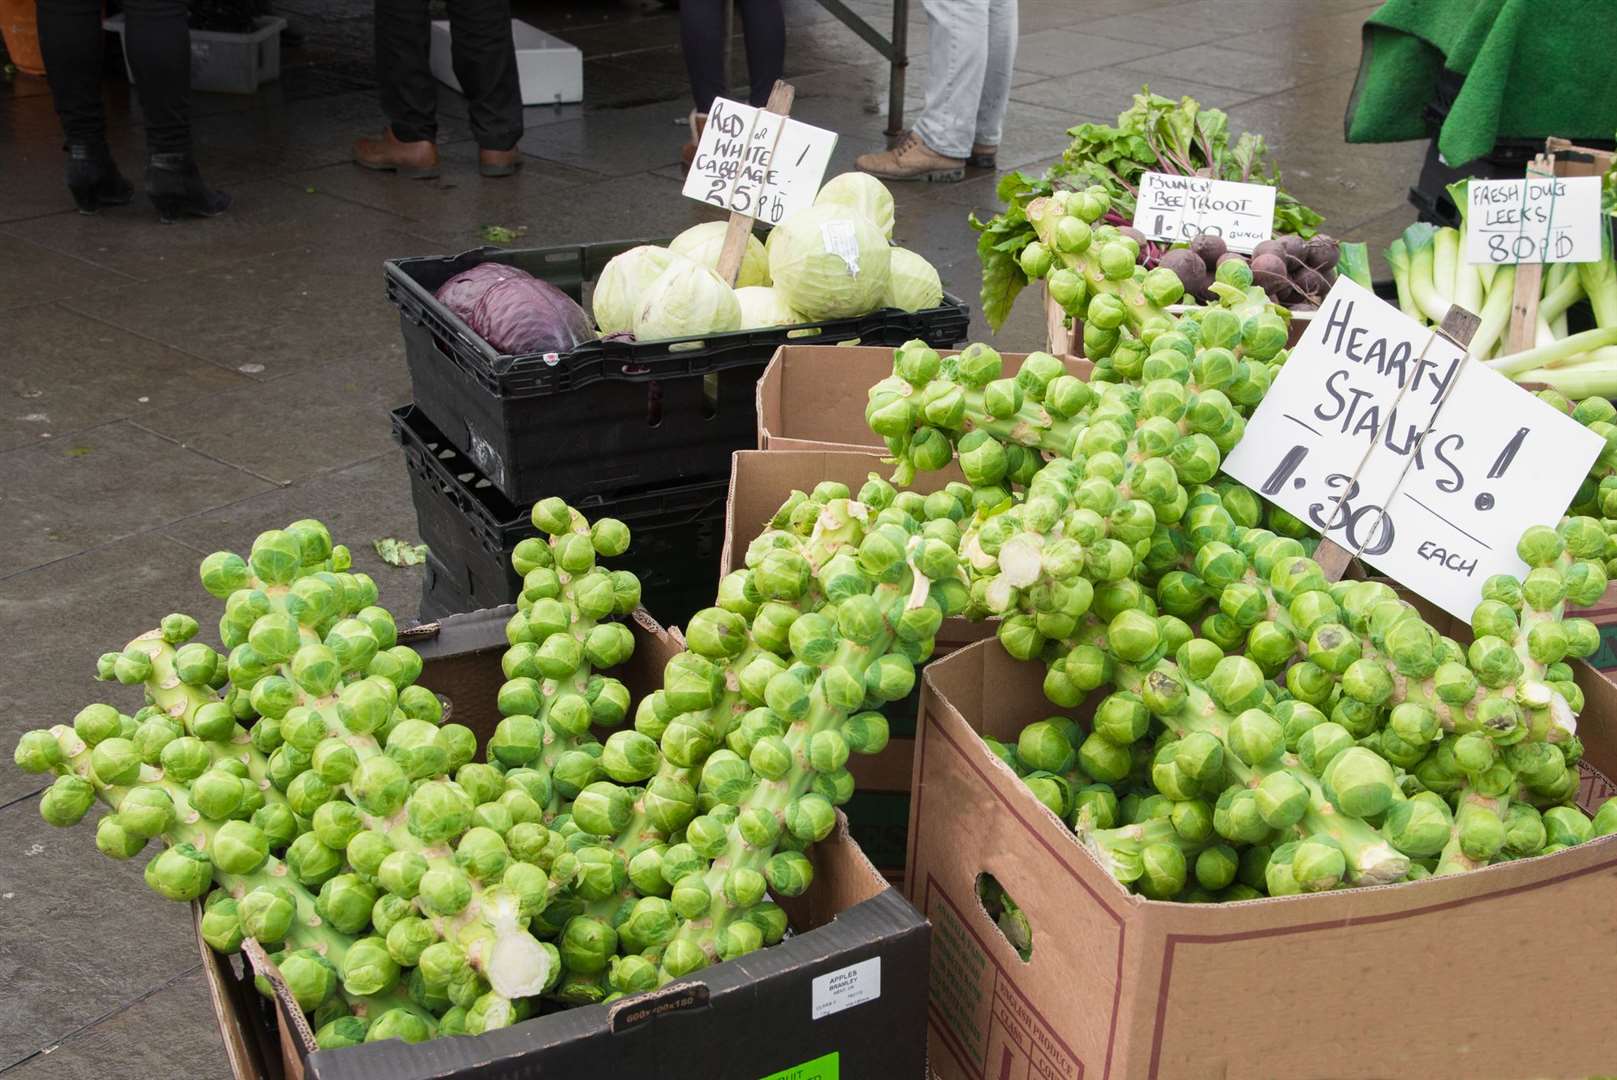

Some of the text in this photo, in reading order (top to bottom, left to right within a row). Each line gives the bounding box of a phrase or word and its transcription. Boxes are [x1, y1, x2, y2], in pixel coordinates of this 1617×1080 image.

[711, 102, 744, 138] RED
[713, 138, 771, 166] WHITE
[697, 154, 779, 185] CABBAGE
[1473, 183, 1567, 206] FRESH DUG
[1486, 206, 1547, 226] LEEKS
[1321, 298, 1460, 405] HEARTY
[1260, 445, 1395, 555] 1.30
[1416, 540, 1480, 578] EACH
[828, 977, 858, 991] BRAMLEY
[829, 970, 858, 984] APPLES
[1000, 1009, 1024, 1044] CLASS
[1001, 982, 1073, 1079] ENGLISH PRODUCE
